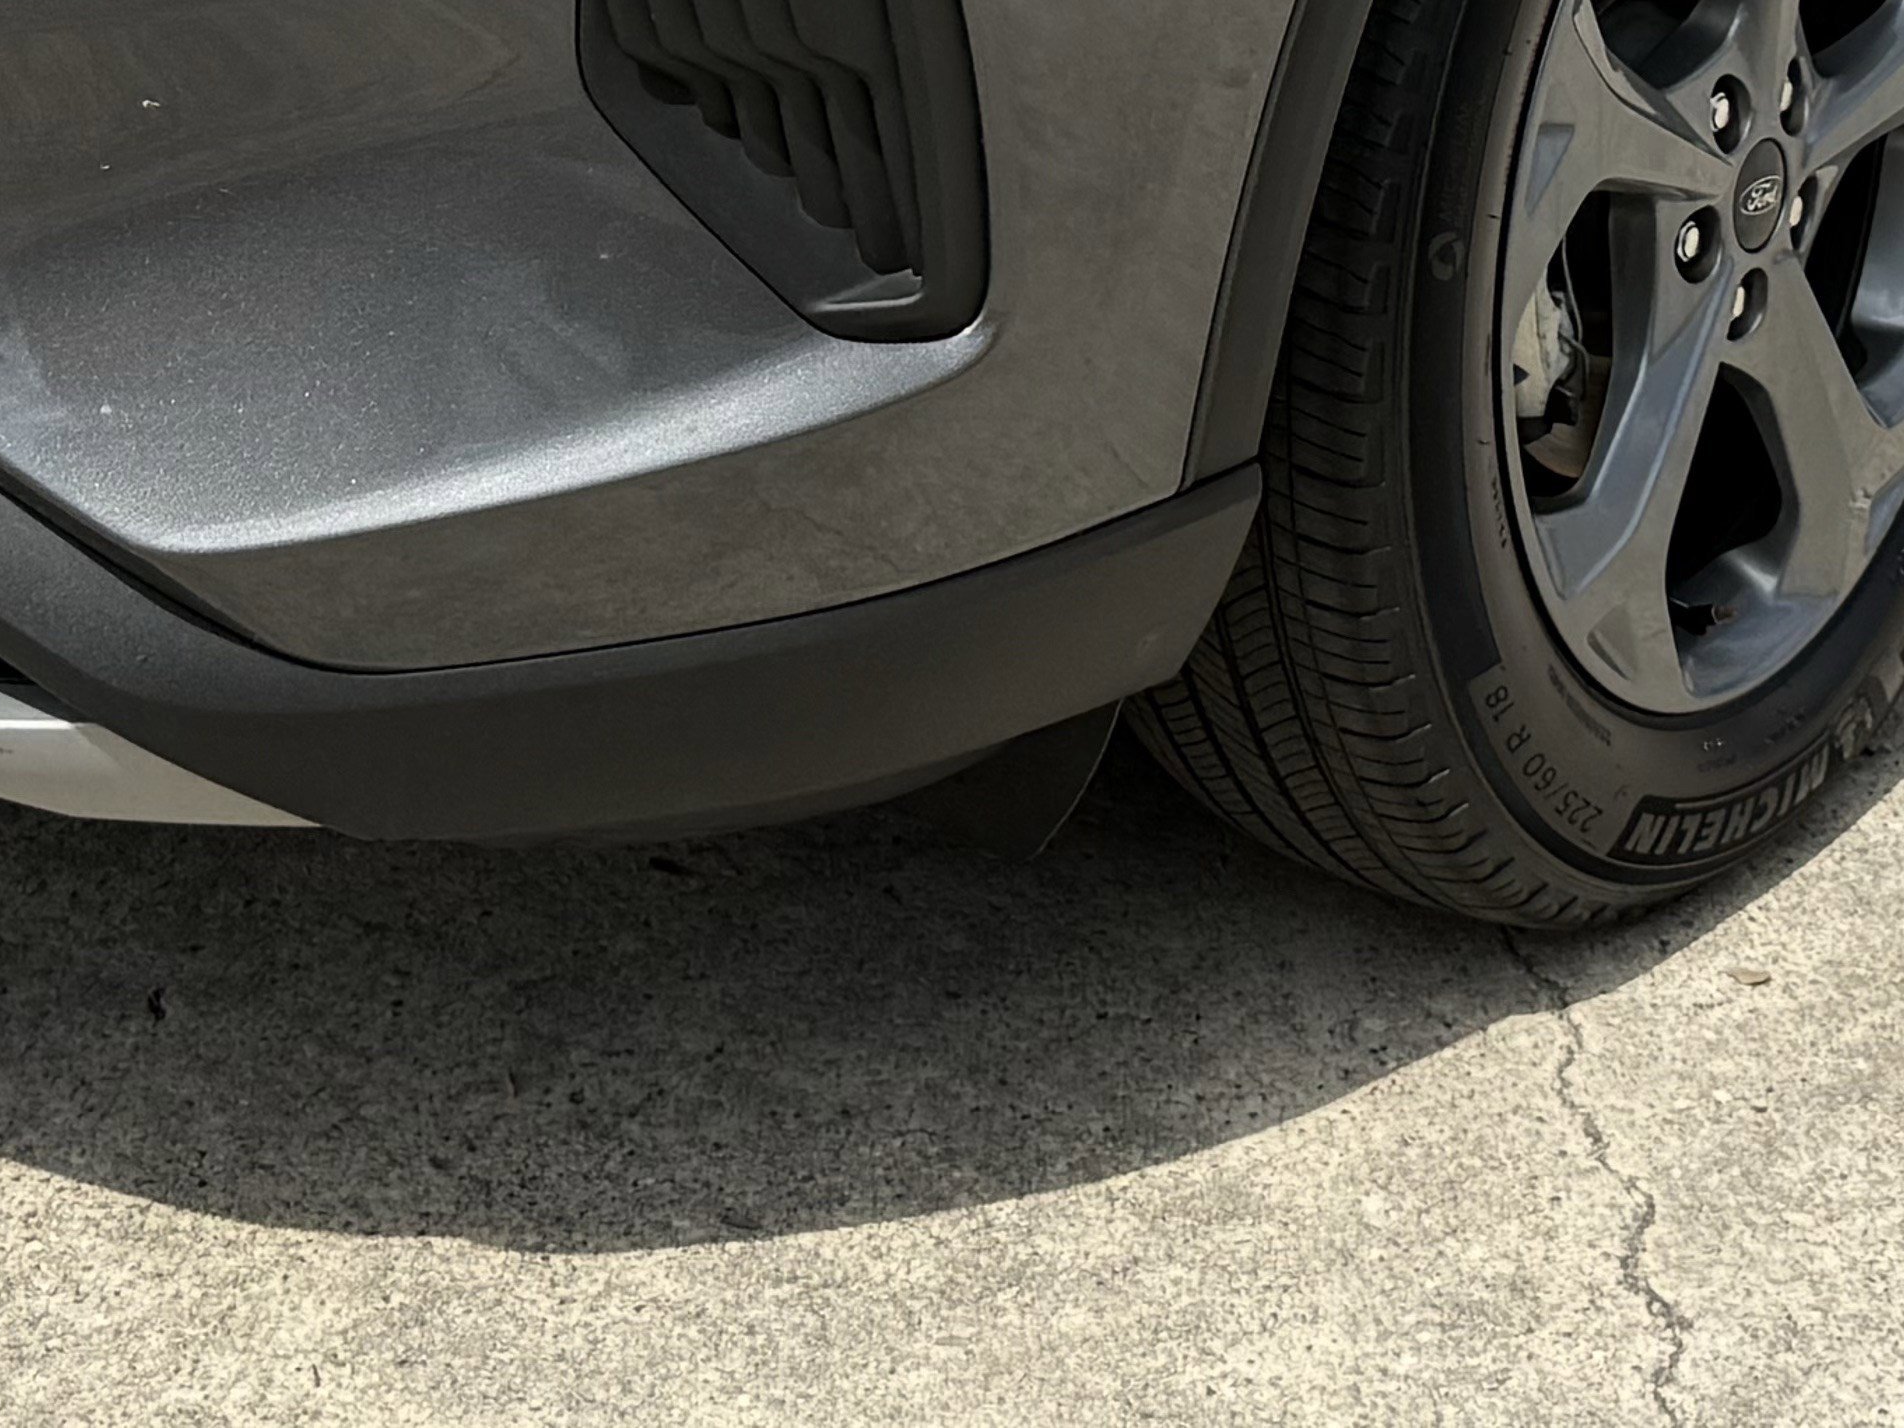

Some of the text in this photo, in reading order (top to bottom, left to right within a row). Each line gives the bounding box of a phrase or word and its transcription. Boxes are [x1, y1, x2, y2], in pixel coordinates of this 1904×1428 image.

[1747, 183, 1778, 211] Ford
[1485, 684, 1516, 723] 18
[1506, 726, 1532, 752] R
[1521, 752, 1603, 832] 225/60
[1624, 746, 1831, 855] MICHELIN
